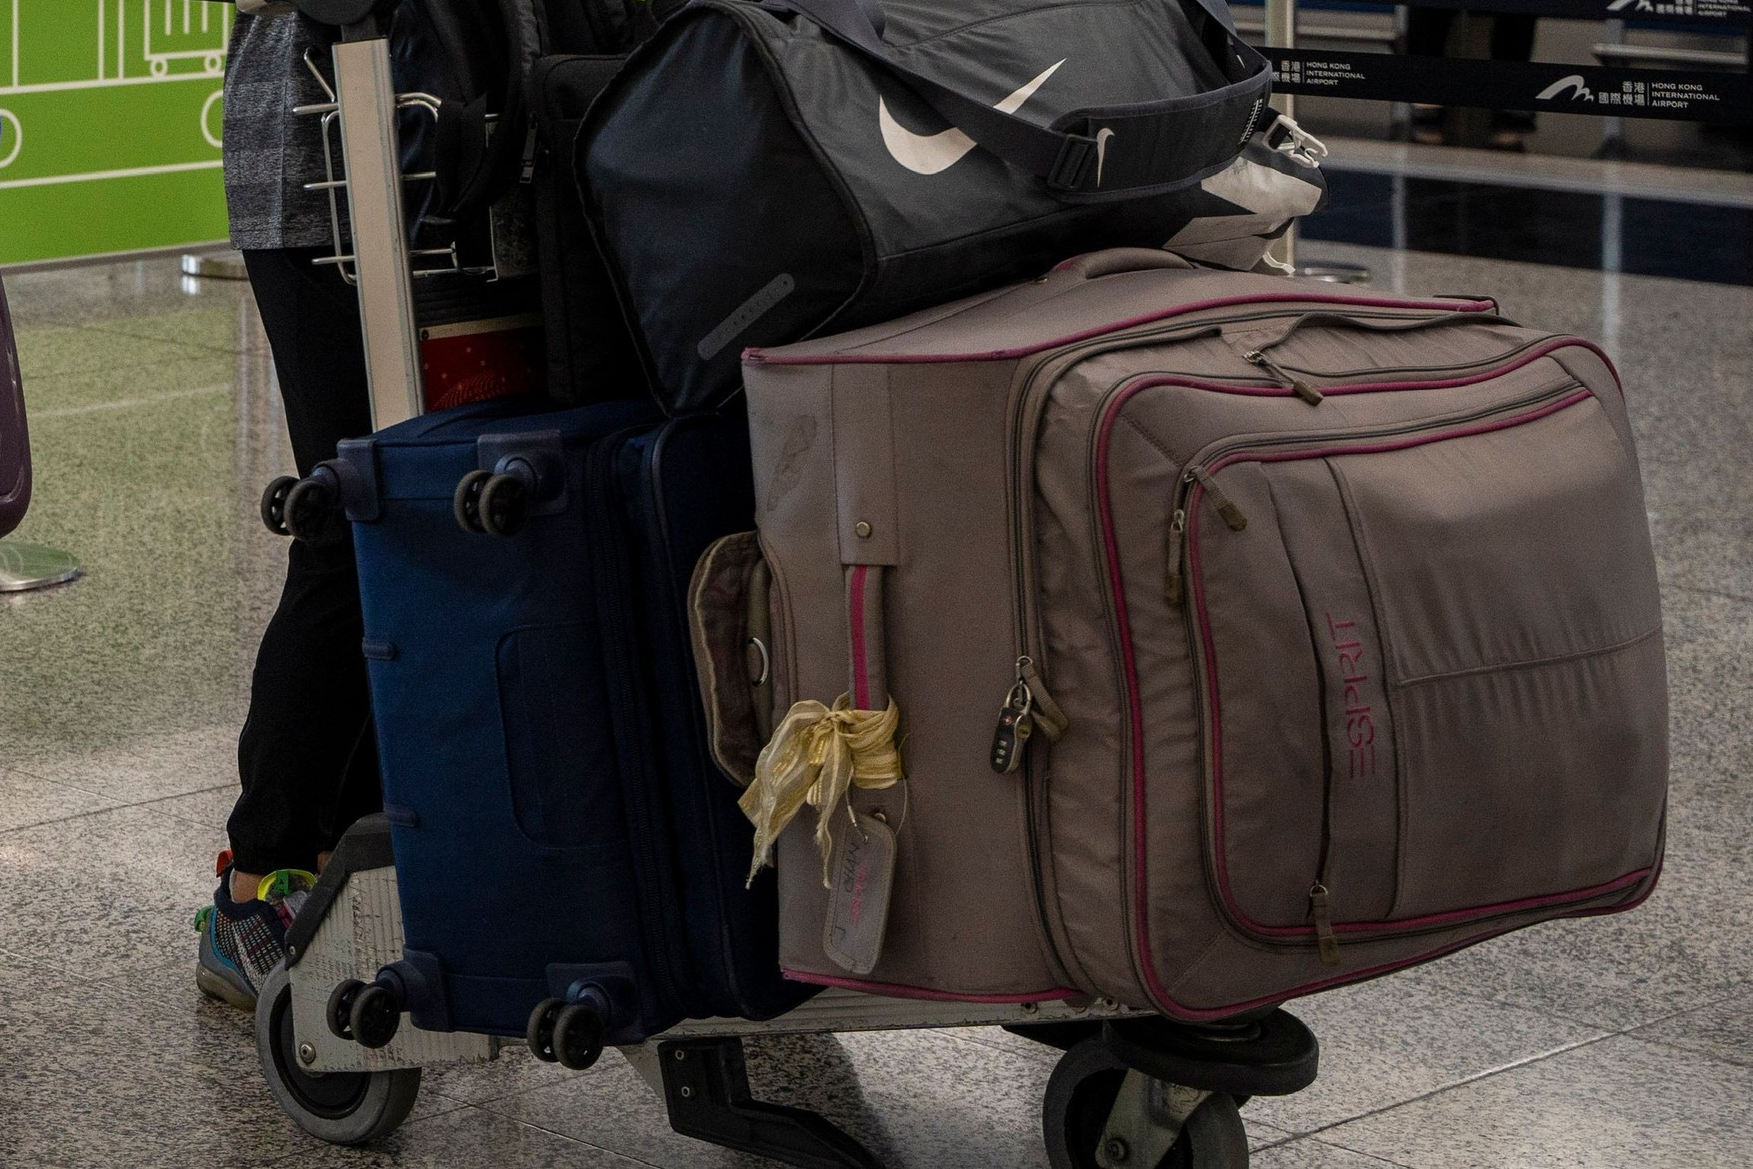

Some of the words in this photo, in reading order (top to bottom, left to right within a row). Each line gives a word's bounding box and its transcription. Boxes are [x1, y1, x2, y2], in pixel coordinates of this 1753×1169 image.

[1306, 61, 1328, 69] HONG
[1329, 62, 1351, 70] KONG
[1271, 71, 1301, 83] 際機場
[1306, 70, 1366, 80] INTERNATIONAL
[1622, 80, 1645, 93] 香港
[1651, 82, 1677, 90] HONG
[1678, 83, 1703, 91] KONG
[1598, 91, 1645, 106] 國際機場
[1651, 91, 1721, 101] INTERNATIONAL
[1651, 100, 1689, 109] AIRPORT
[1325, 610, 1377, 781] ESPRIT
